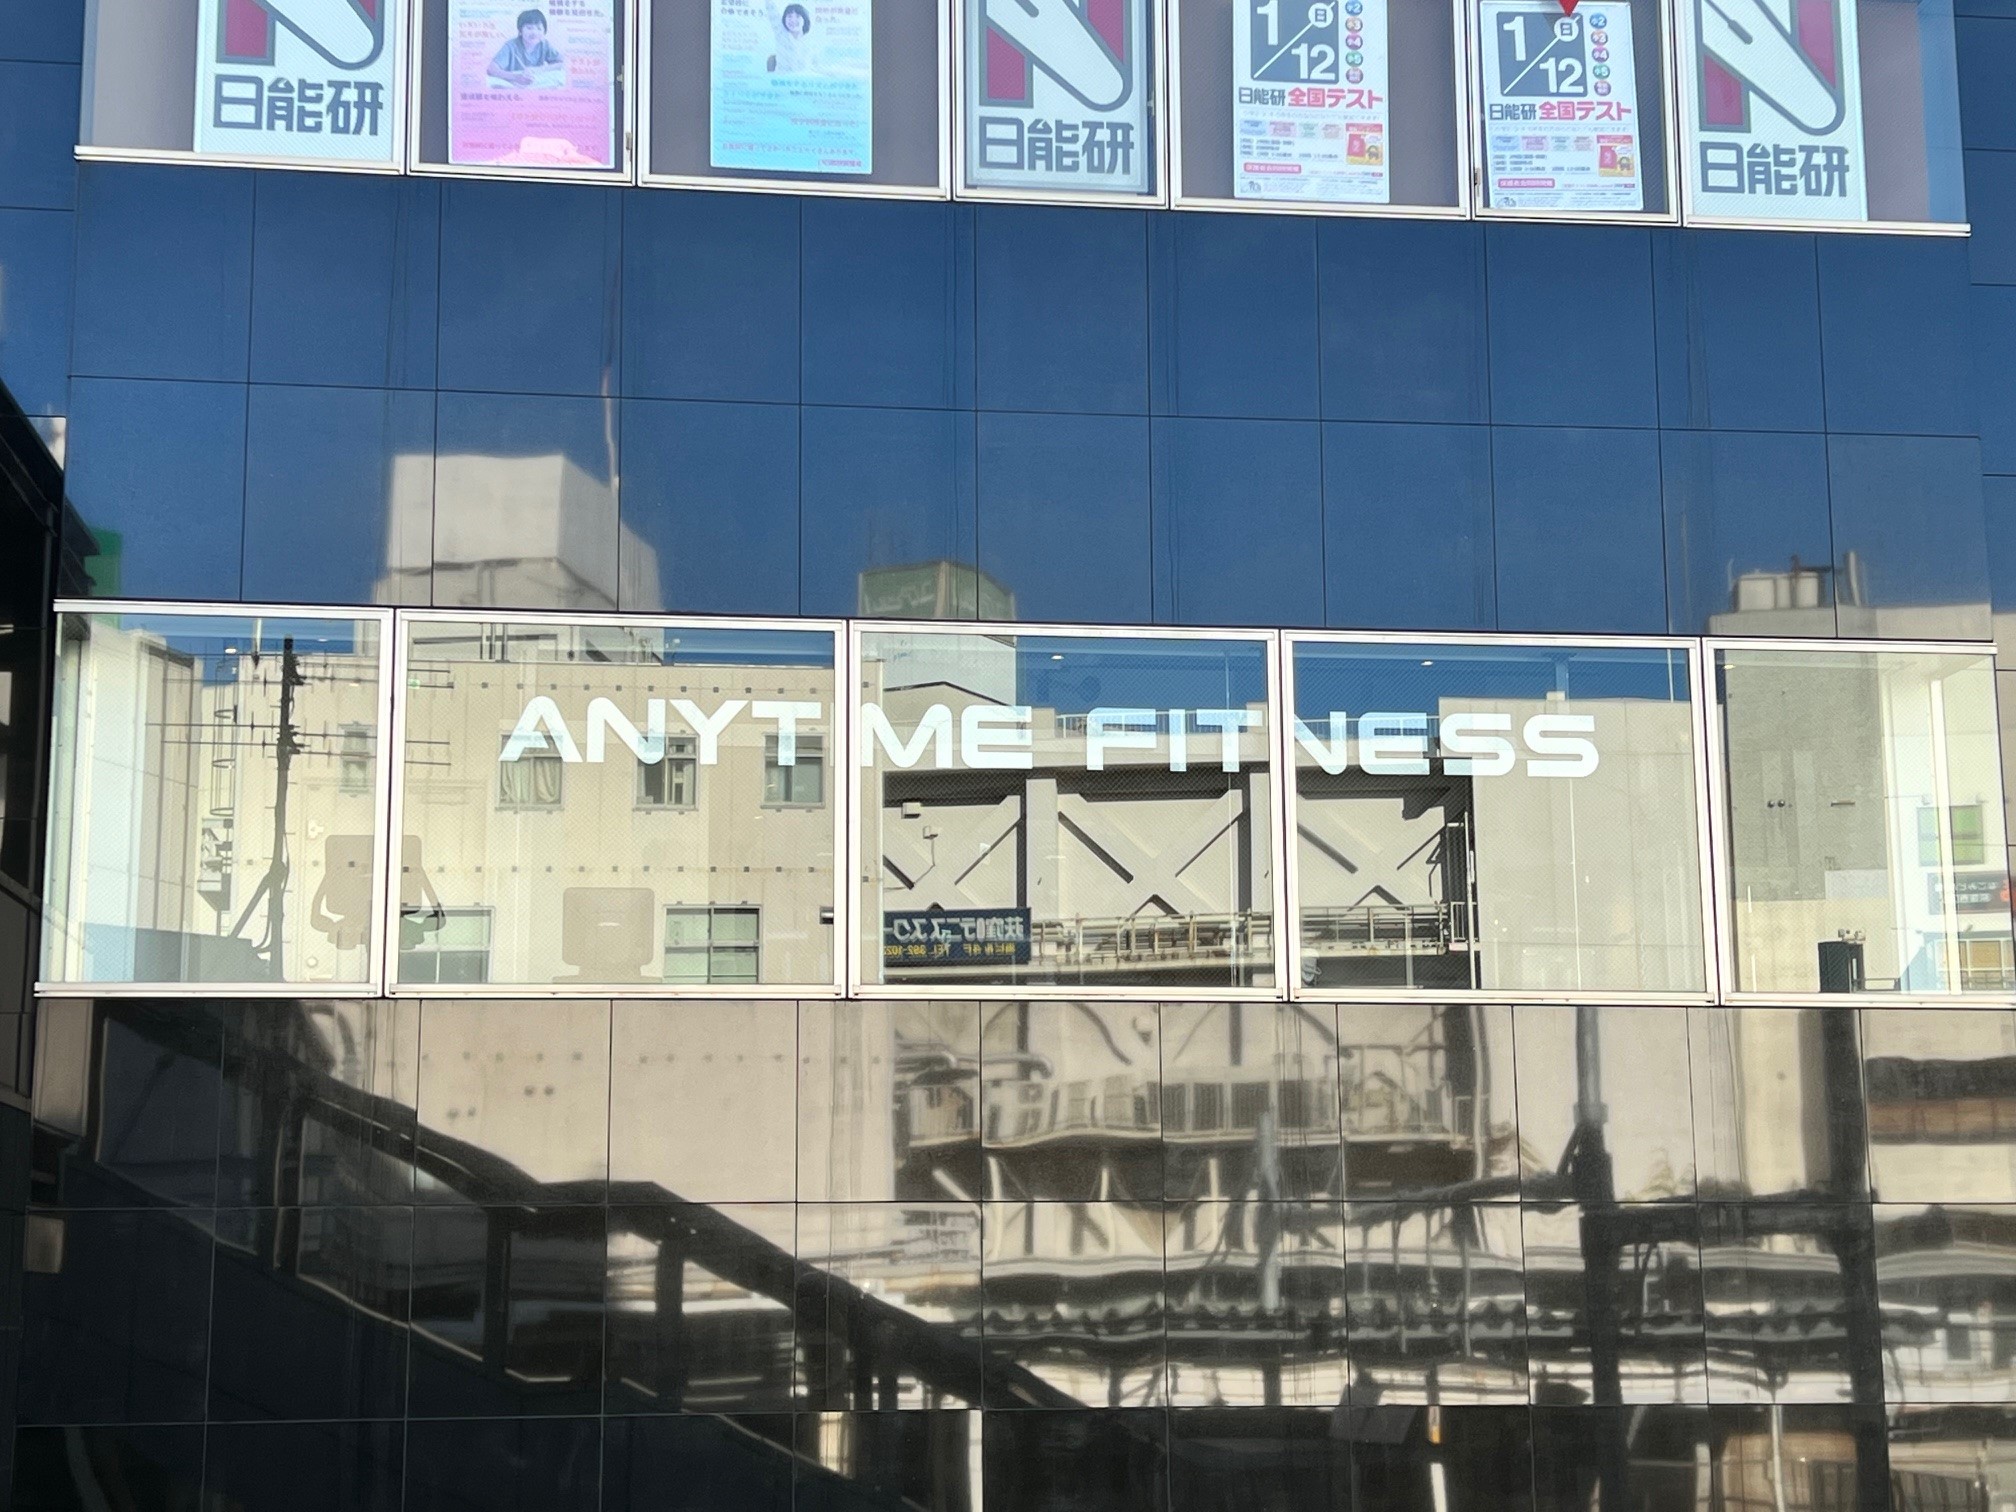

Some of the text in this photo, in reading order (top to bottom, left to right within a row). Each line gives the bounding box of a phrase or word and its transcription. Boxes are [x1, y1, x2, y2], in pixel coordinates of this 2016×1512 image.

[1256, 0, 1279, 45] 1
[1503, 16, 1526, 61] 1
[1291, 43, 1335, 80] 12
[1539, 57, 1585, 93] 12
[213, 74, 384, 136] 日能研
[1238, 87, 1384, 109] 日能研 全国テスト
[1489, 101, 1632, 121] 日能研 全国テスト
[978, 116, 1135, 175] 日能研
[1699, 141, 1850, 197] 日能研
[498, 695, 1600, 778] ANYTME FITNESS
